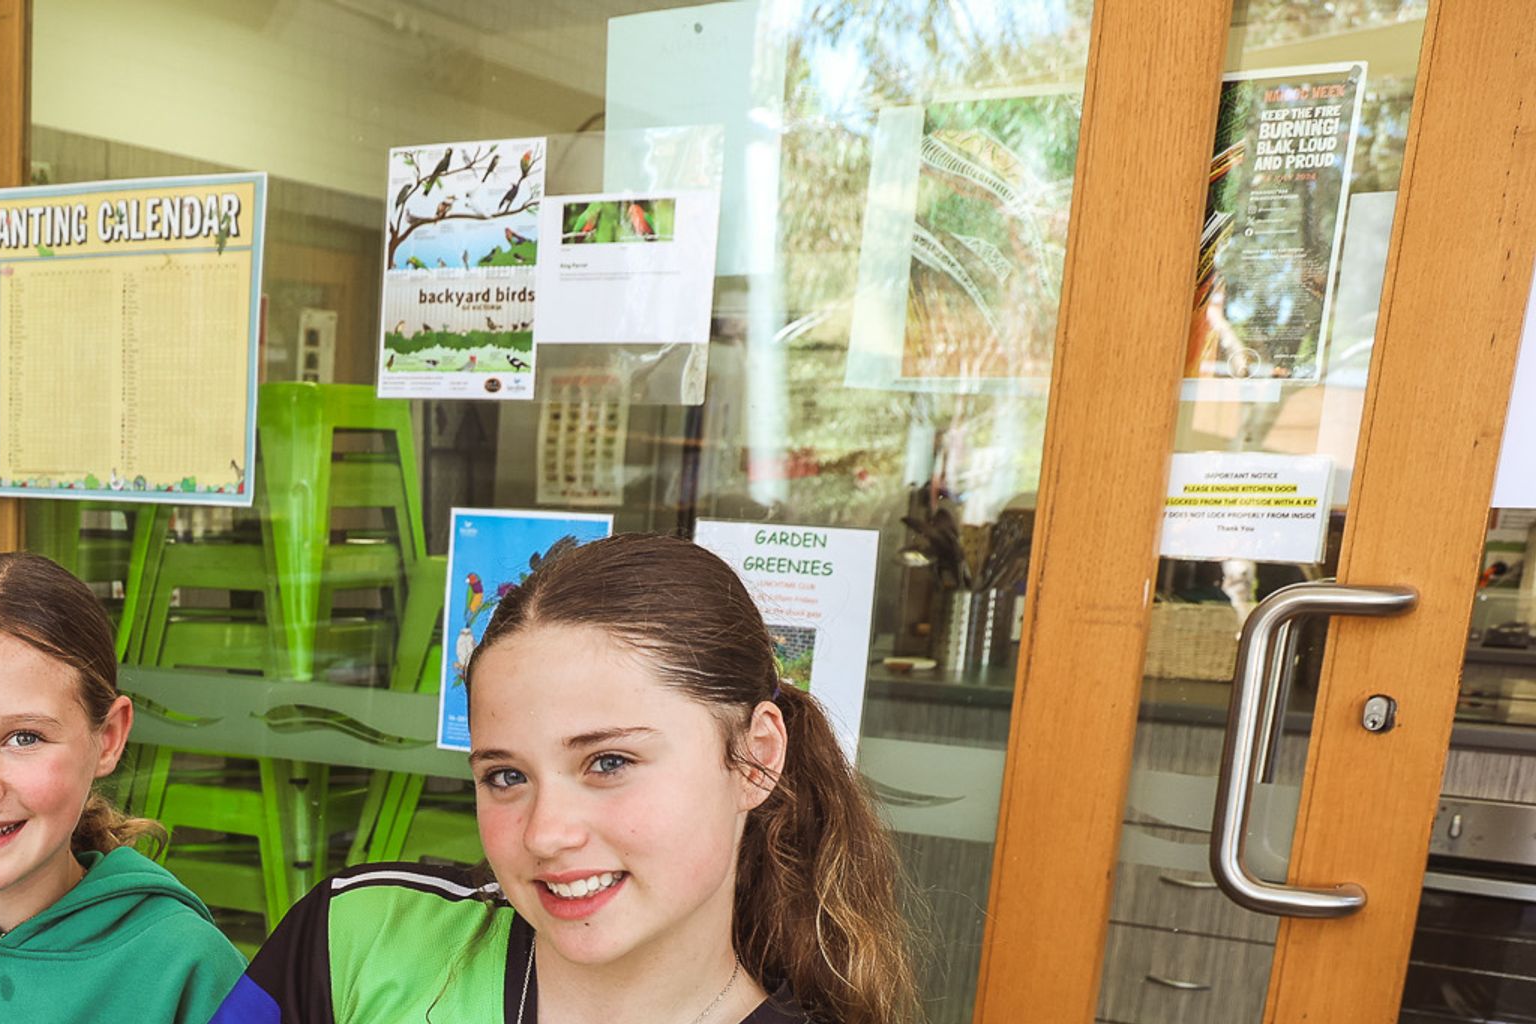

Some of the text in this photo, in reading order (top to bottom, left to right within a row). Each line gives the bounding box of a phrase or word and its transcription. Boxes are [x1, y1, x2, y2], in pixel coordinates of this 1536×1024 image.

[1261, 105, 1342, 121] KEEP THE FIRE
[1258, 118, 1340, 140] BURNING!
[1256, 136, 1337, 157] BLAK, LOUD
[1254, 152, 1336, 171] AND PROUD
[97, 192, 241, 243] CALENDAR
[418, 286, 535, 307] backyard birds
[755, 529, 827, 548] GARDEN
[744, 556, 833, 576] GREENIES
